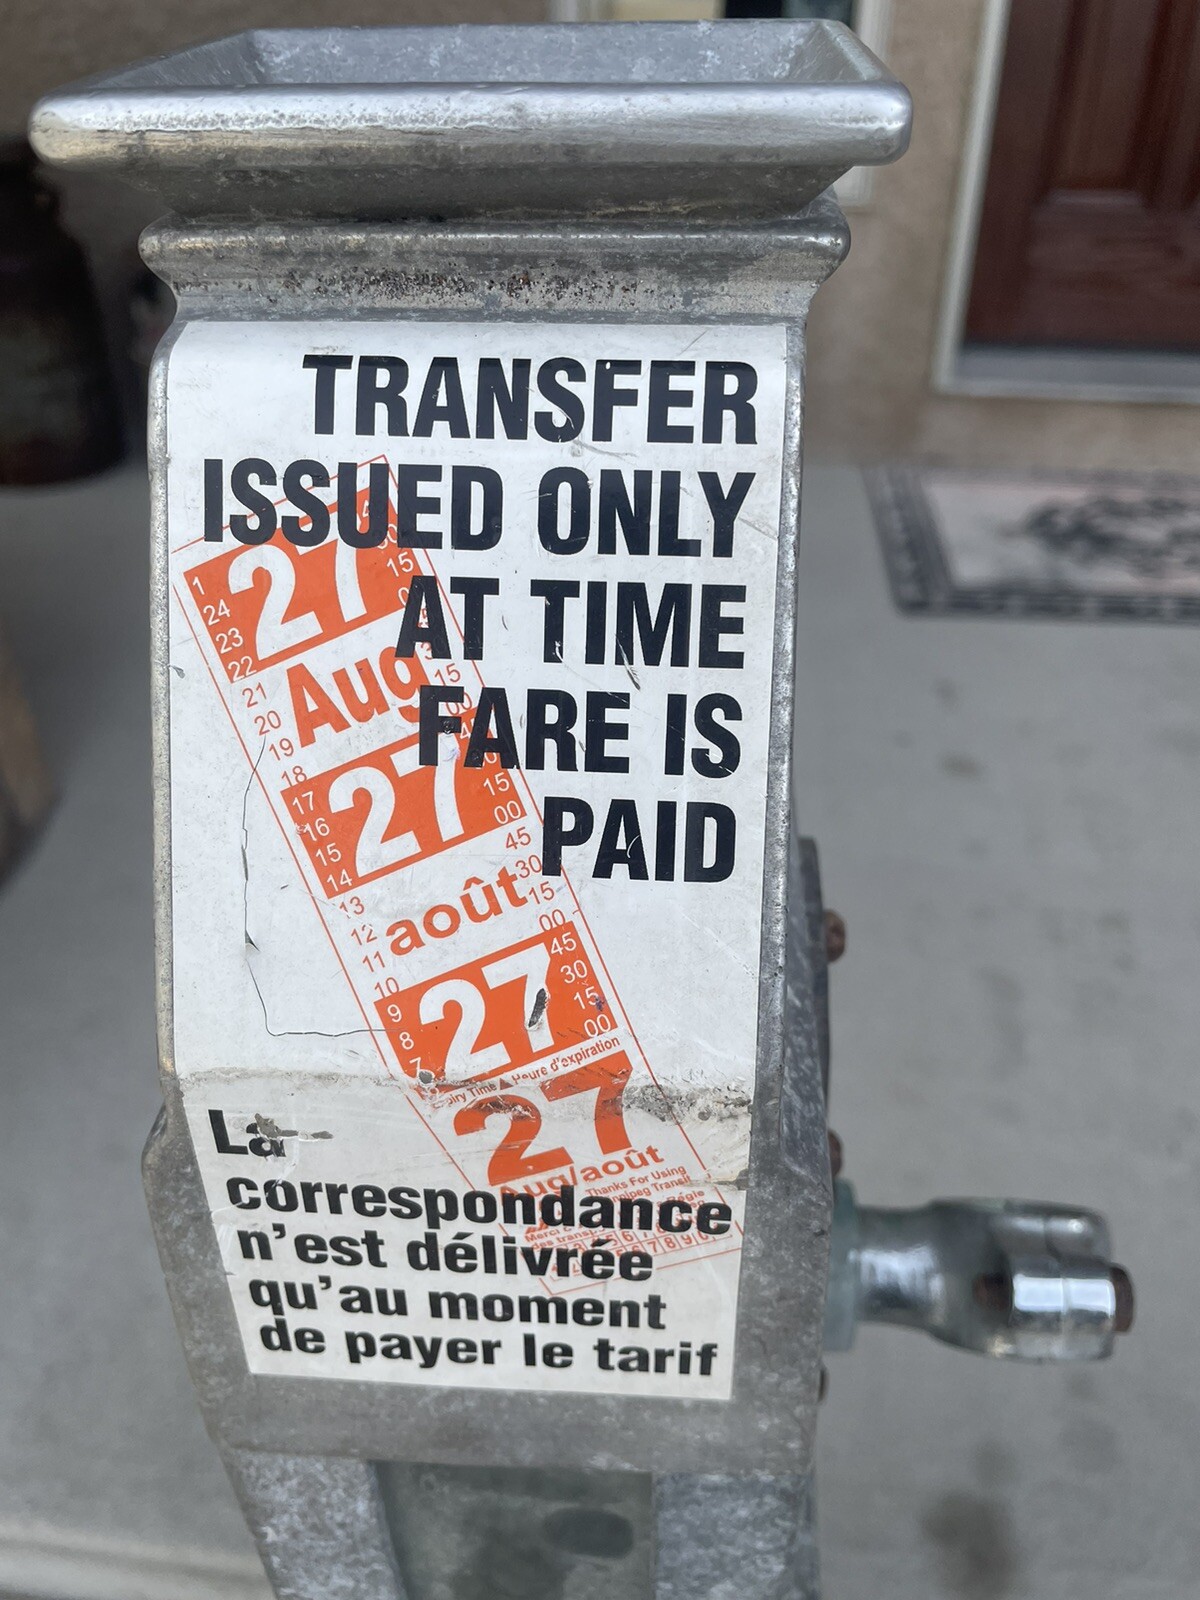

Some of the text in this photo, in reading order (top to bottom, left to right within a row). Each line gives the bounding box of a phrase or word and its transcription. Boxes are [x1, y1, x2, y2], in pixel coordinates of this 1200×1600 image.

[302, 354, 758, 445] TRANSFER
[203, 457, 756, 558] ISSUED ONLY
[386, 551, 414, 578] 15
[192, 576, 205, 595] 1
[228, 510, 367, 661] 27
[203, 598, 231, 626] 24
[394, 576, 746, 669] AT TIME
[215, 627, 243, 654] 23
[228, 655, 257, 682] 22
[434, 662, 461, 686] 15
[242, 681, 267, 708] 21
[287, 646, 431, 748] Aug
[254, 710, 281, 736] 20
[418, 684, 743, 779] FARE IS
[269, 738, 295, 761] 19
[281, 765, 307, 787] 18
[483, 772, 510, 796] 15
[292, 790, 314, 815] 17
[329, 732, 464, 878] 27
[493, 800, 521, 825] 00
[303, 817, 330, 842] 16
[505, 826, 531, 850] 45
[541, 796, 737, 884] PAID
[316, 842, 342, 867] 15
[515, 854, 542, 879] 30
[327, 868, 352, 892] 14
[528, 881, 555, 905] 15
[339, 896, 365, 919] 13
[386, 866, 528, 956] août
[538, 908, 566, 932] 00
[351, 923, 378, 946] 12
[550, 932, 577, 956] 45
[362, 950, 386, 973] 11
[559, 959, 588, 984] 30
[374, 976, 400, 999] 10
[573, 985, 600, 1010] 15
[387, 1004, 402, 1023] 9
[419, 942, 554, 1080] 27
[583, 1013, 611, 1038] 00
[399, 1031, 414, 1050] 8
[409, 1056, 422, 1077] 7
[467, 1081, 498, 1098] Time
[454, 1050, 633, 1187] 27
[208, 1109, 286, 1158] La
[585, 1165, 687, 1197] Thanks For Using
[651, 1175, 691, 1193] Transit
[226, 1177, 732, 1235] correspondance
[237, 1223, 653, 1282] n'est délivrée
[249, 1275, 667, 1330] qu'au moment
[259, 1318, 718, 1377] de payer le tarif
